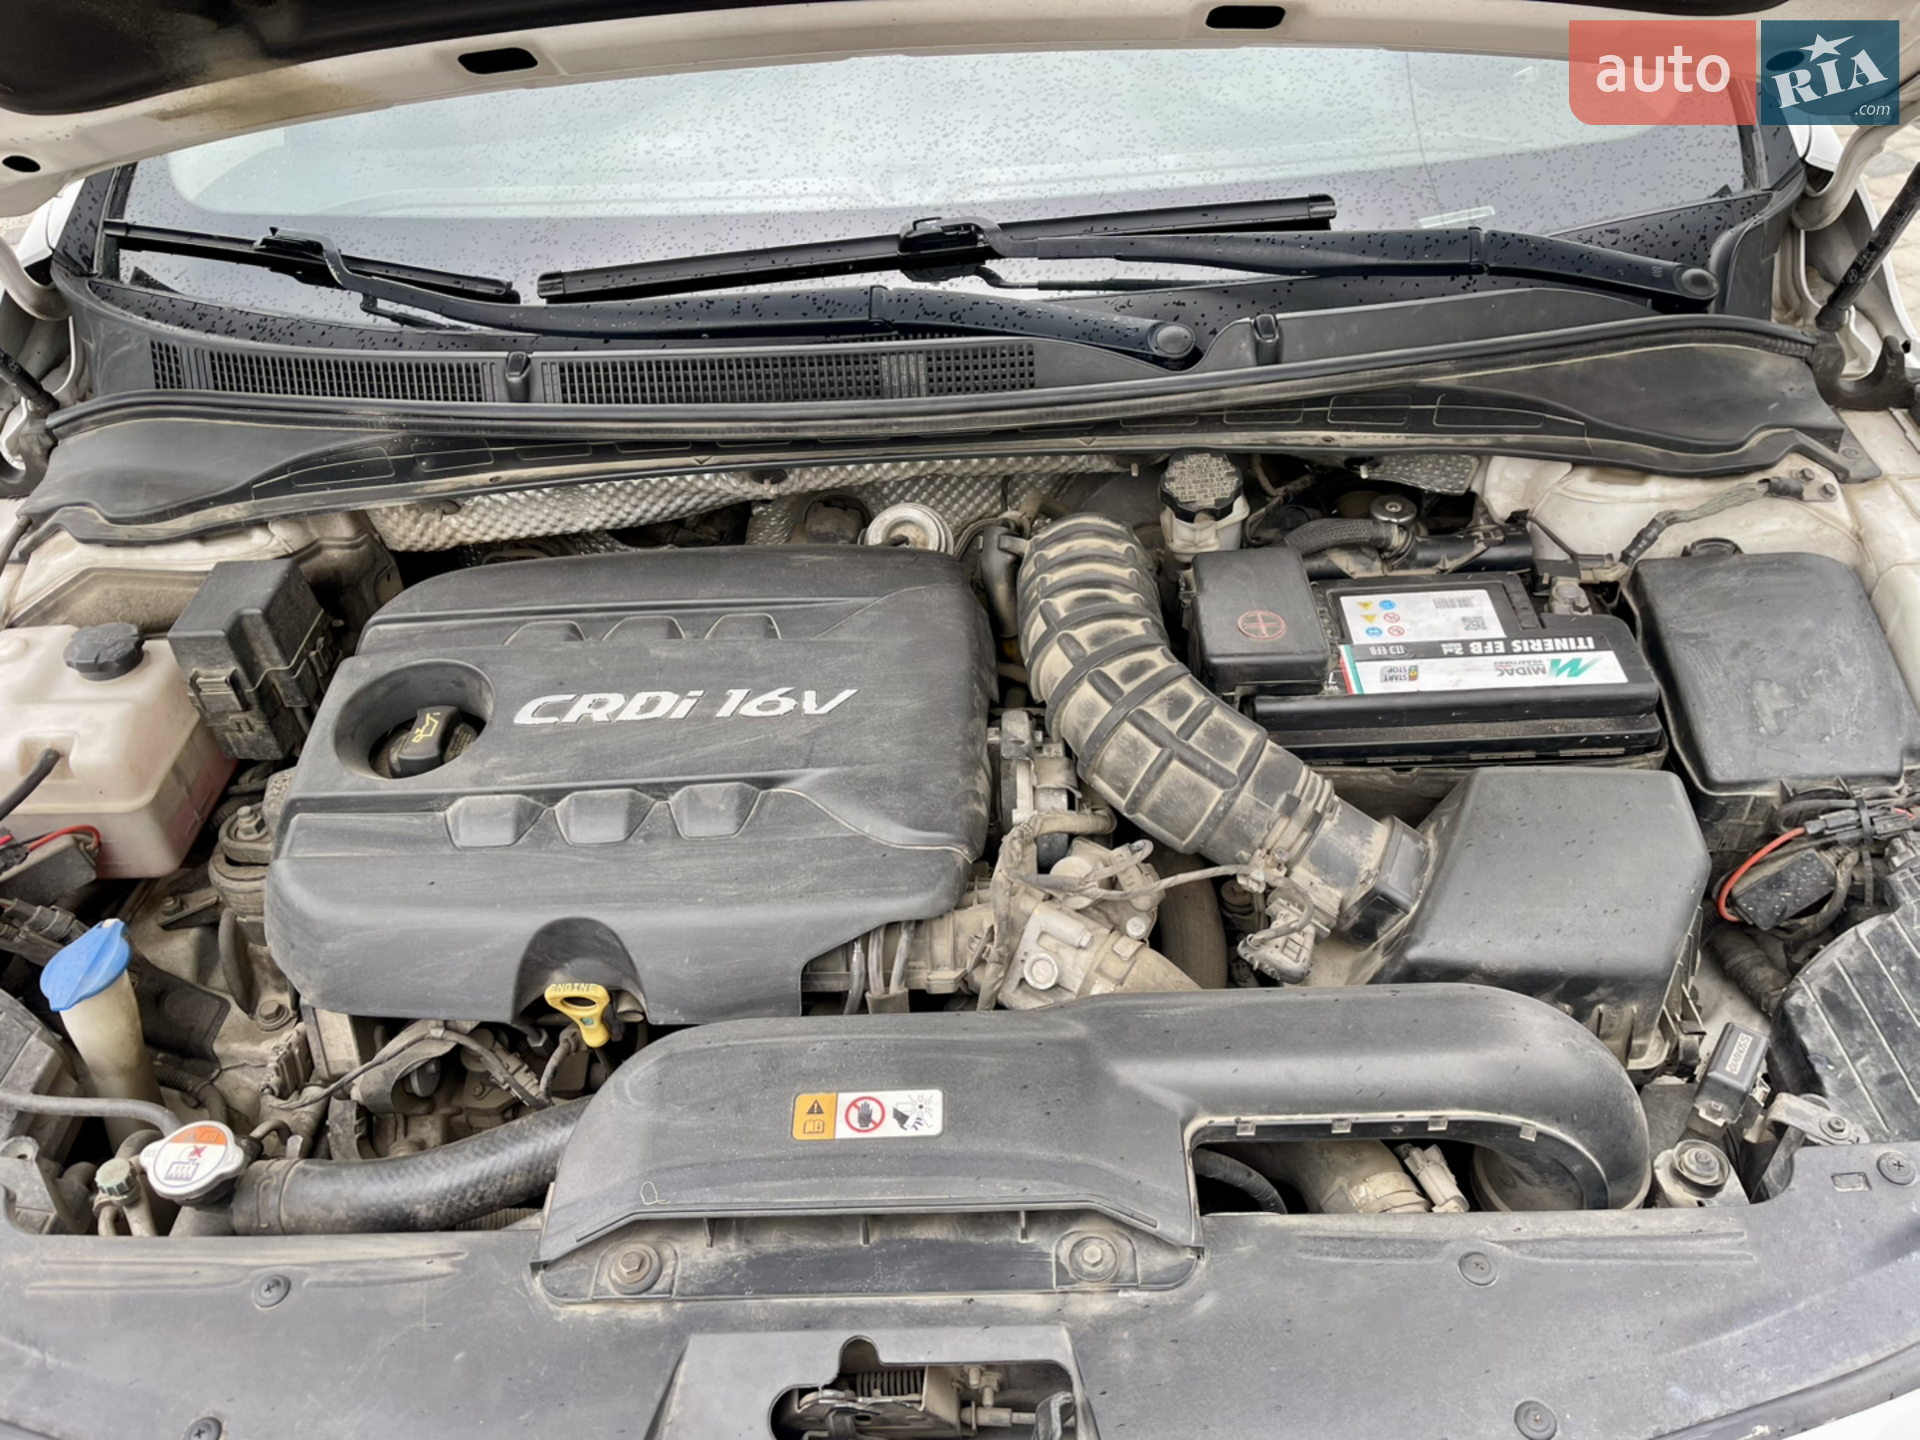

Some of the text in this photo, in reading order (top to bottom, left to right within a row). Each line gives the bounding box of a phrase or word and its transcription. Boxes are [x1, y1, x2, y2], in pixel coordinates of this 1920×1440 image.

[1469, 640, 1505, 655] EFB
[1511, 636, 1595, 653] ITINERIS
[1369, 646, 1387, 656] EFB
[1387, 666, 1407, 674] STOP
[1495, 665, 1547, 677] MIDAC
[1384, 674, 1408, 682] START
[513, 686, 861, 725] CRDi 16V
[549, 982, 598, 993] ENGINE
